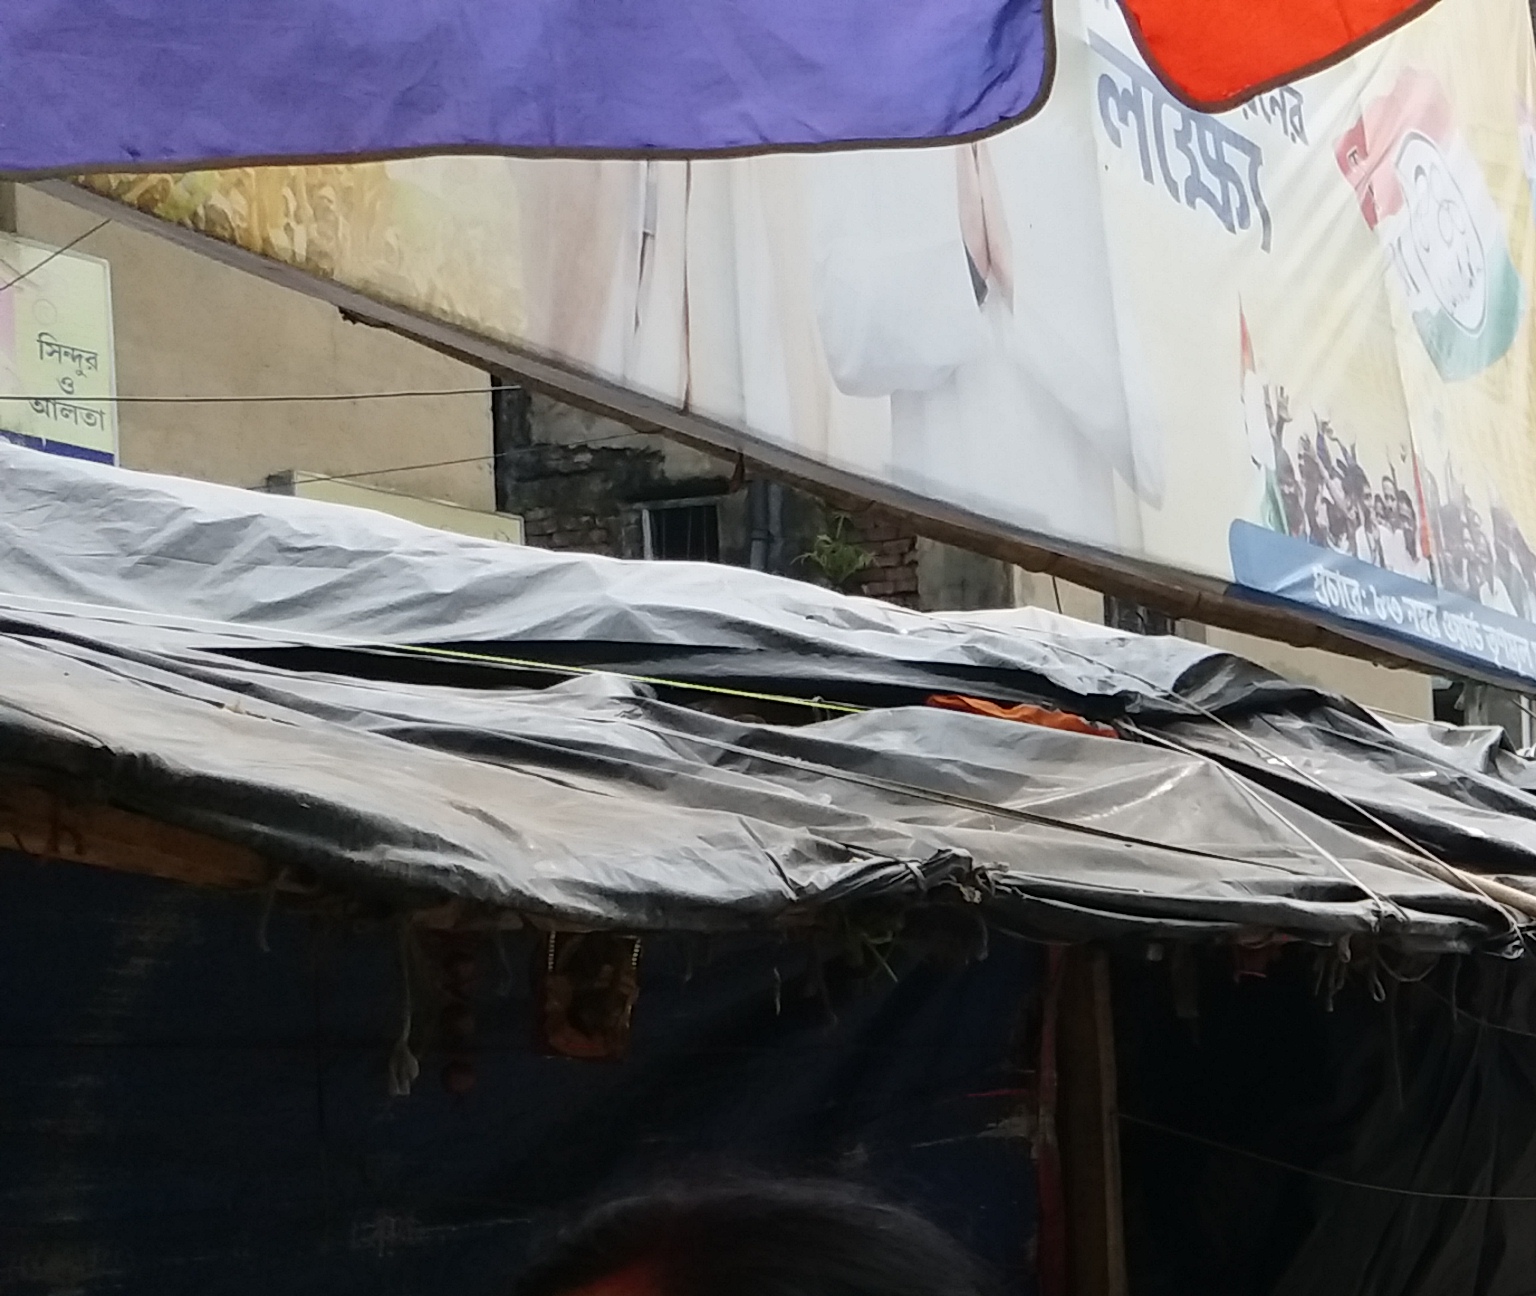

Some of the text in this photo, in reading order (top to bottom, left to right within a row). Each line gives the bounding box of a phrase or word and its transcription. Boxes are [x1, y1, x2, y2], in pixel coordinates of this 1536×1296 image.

[36, 331, 99, 378] সিন্দুর
[56, 376, 75, 395] ও
[28, 398, 106, 431] আলতা
